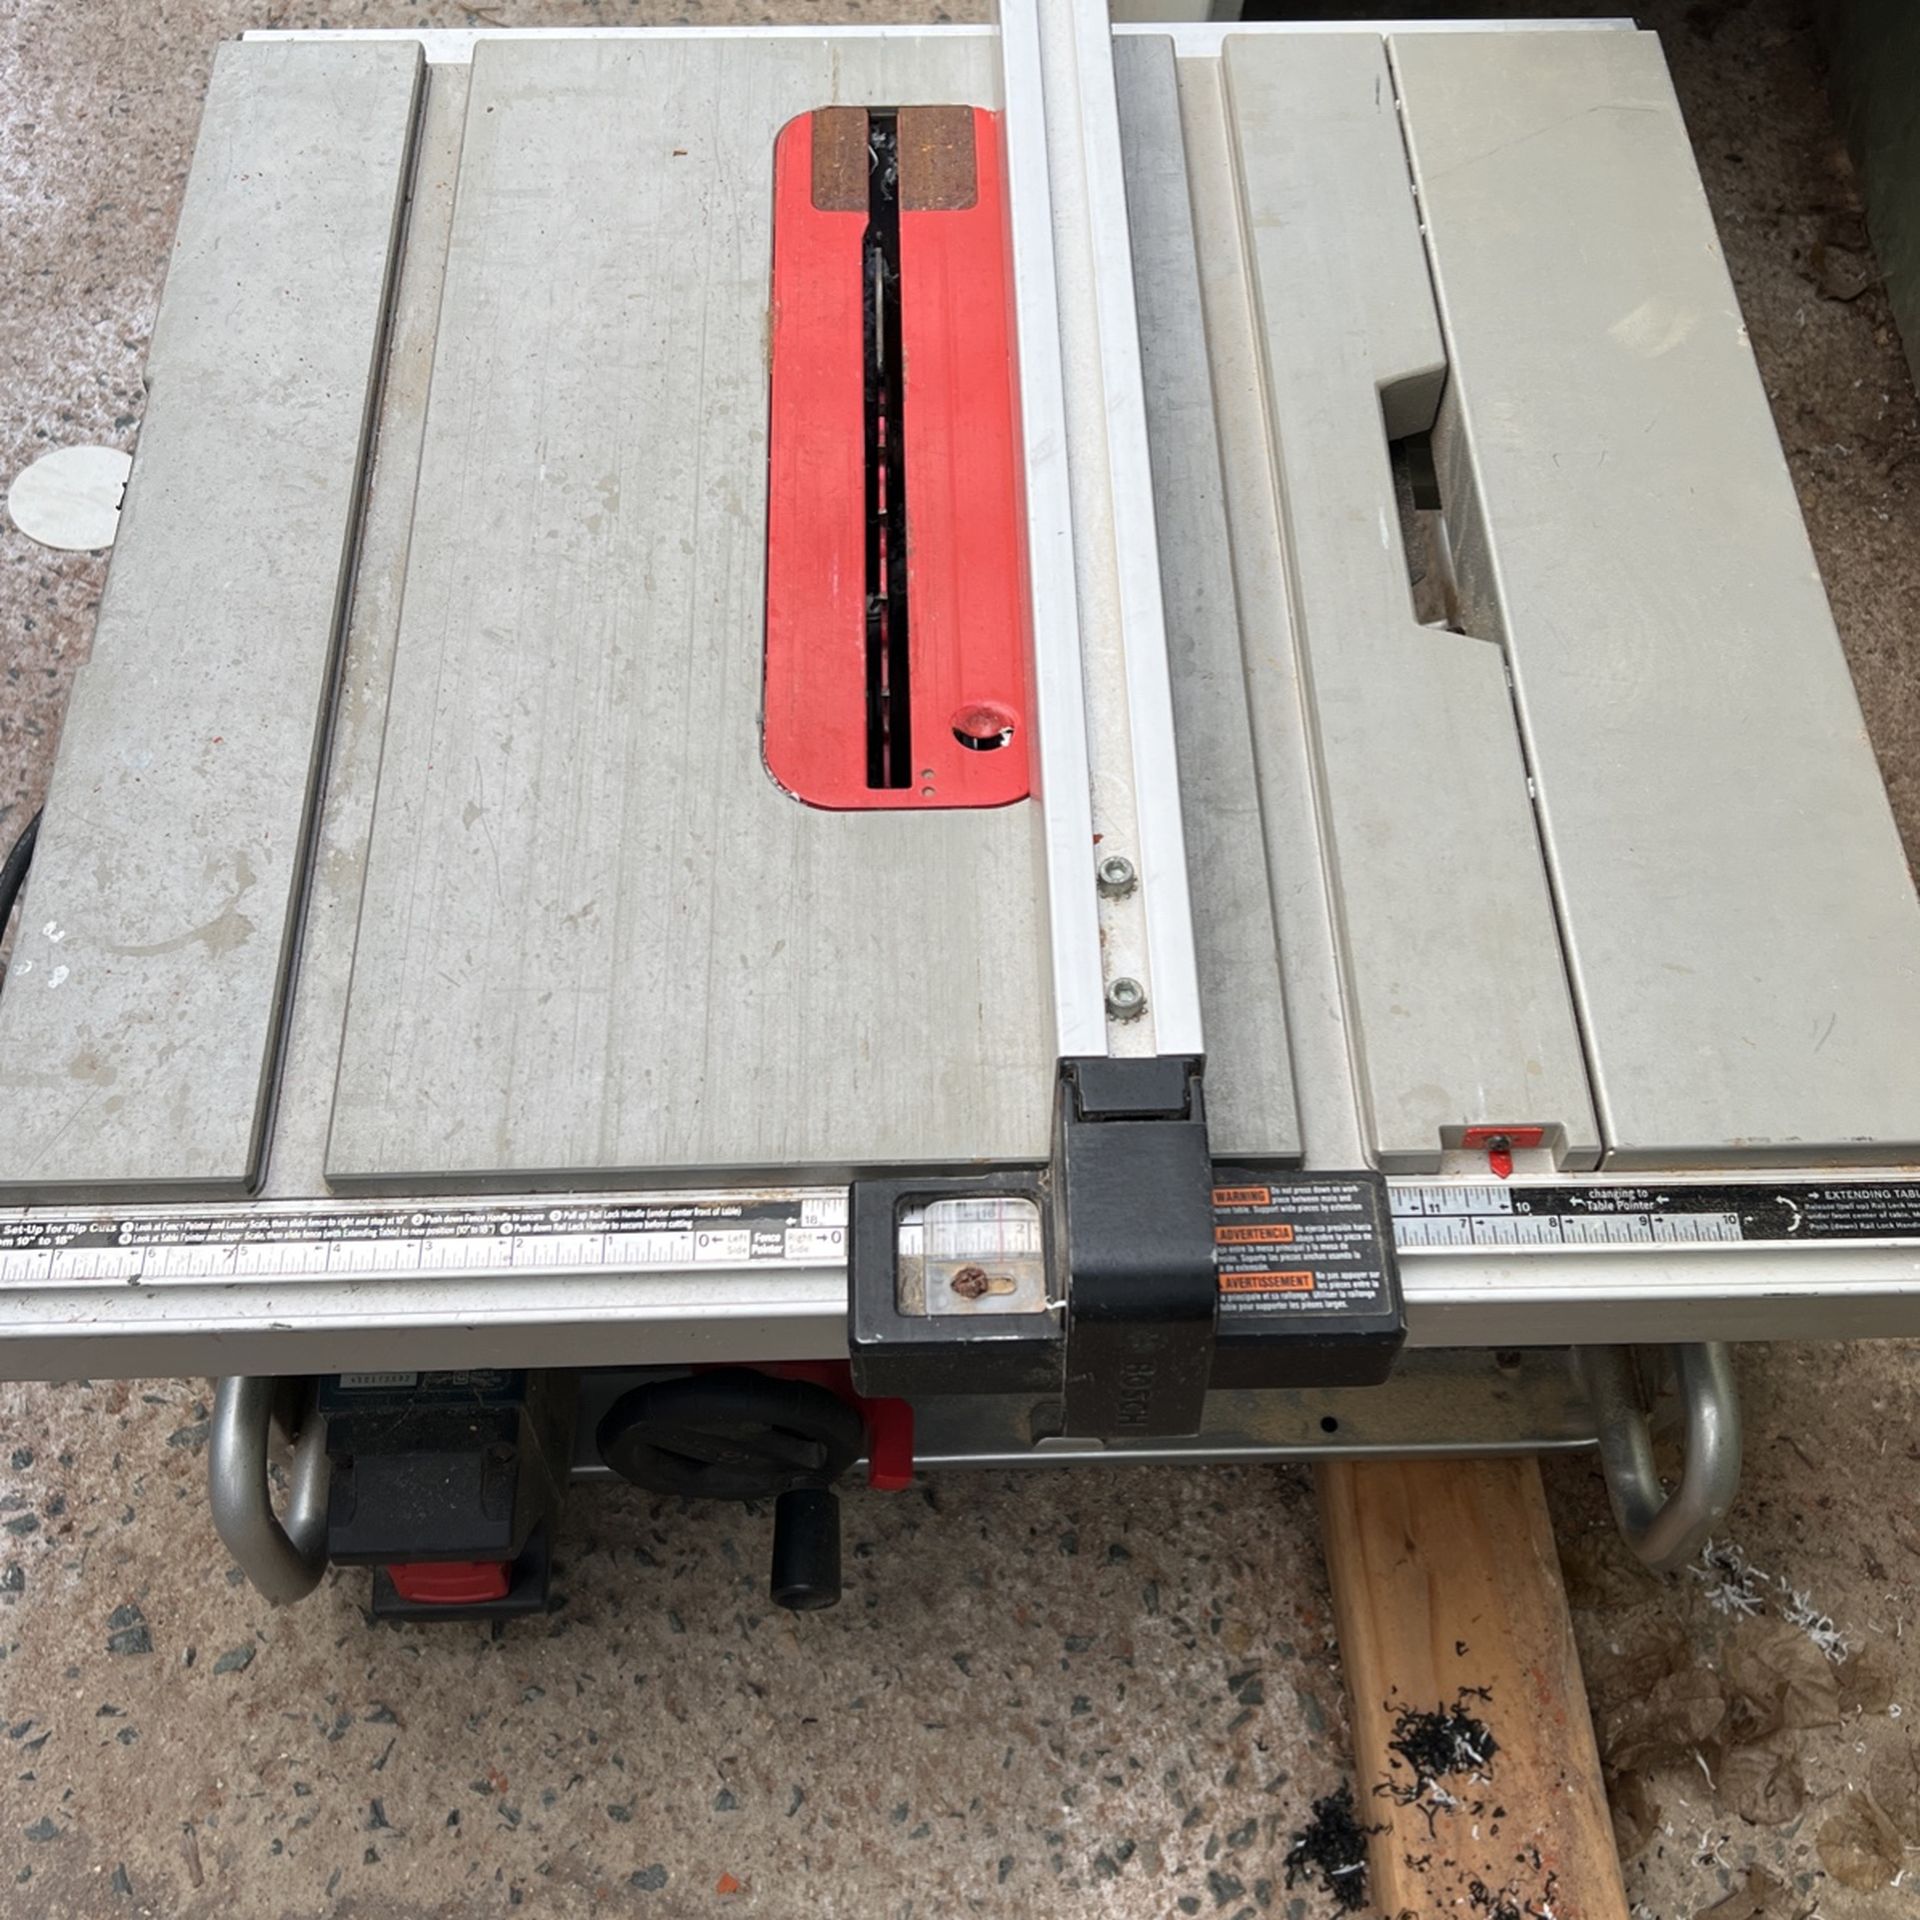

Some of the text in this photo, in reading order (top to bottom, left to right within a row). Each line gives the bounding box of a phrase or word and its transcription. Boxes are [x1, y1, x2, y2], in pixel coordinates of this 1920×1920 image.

[1214, 1191, 1265, 1203] WARNING
[1588, 1189, 1649, 1200] changing to
[1825, 1191, 1891, 1200] EXTENDING
[1429, 1202, 1531, 1213] 11 10
[1586, 1200, 1654, 1211] Table Pointer
[1459, 1215, 1736, 1229] 7 8 9 10
[3, 1225, 44, 1235] Set-Up
[46, 1224, 64, 1234] for
[66, 1223, 87, 1235] Rip
[1016, 1224, 1025, 1234] 2
[1220, 1228, 1289, 1241] ADVERTENCIA
[38, 1236, 51, 1246] to
[699, 1234, 709, 1248] 0
[831, 1230, 842, 1244] 0
[57, 1251, 63, 1261] 7
[149, 1249, 156, 1258] 6
[240, 1246, 248, 1255] 5
[332, 1243, 341, 1252] 4
[425, 1241, 433, 1251] 3
[516, 1238, 525, 1248] 2
[1226, 1275, 1309, 1289] AVERTISSEMENT
[1119, 1363, 1154, 1427] BOSCH
